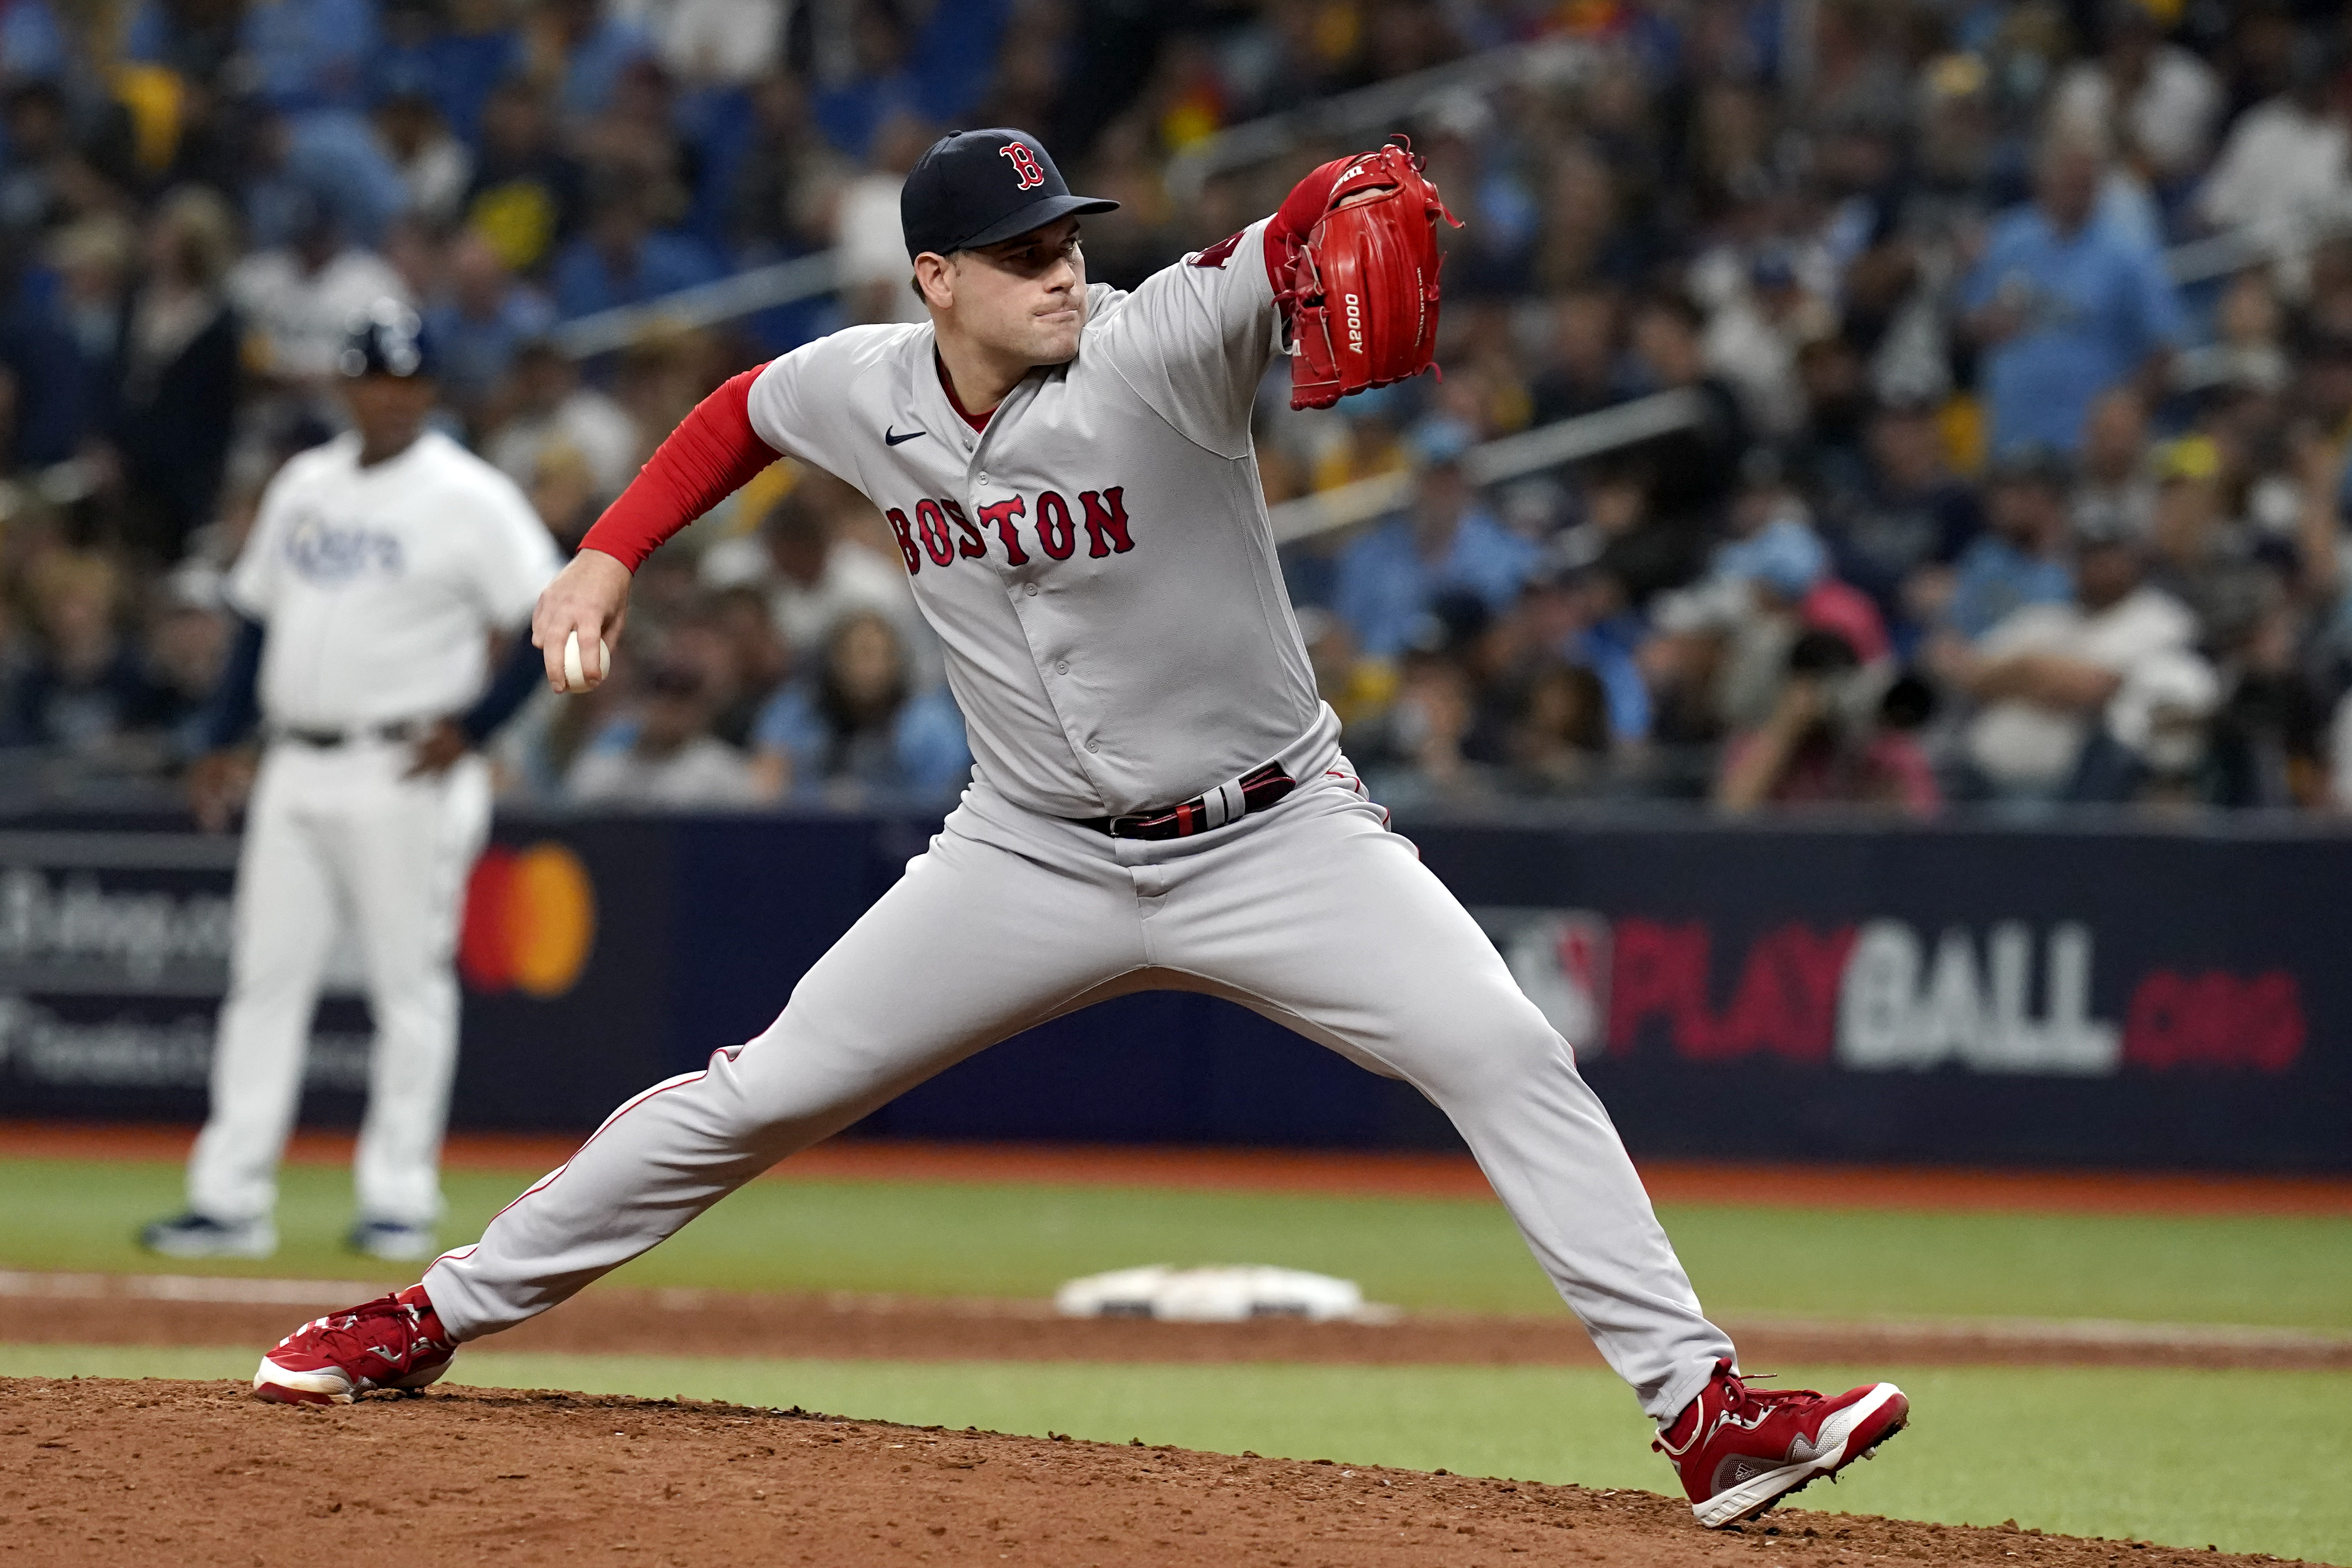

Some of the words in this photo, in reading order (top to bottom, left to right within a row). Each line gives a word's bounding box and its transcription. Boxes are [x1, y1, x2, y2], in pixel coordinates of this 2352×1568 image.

[999, 142, 1044, 191] B
[1345, 294, 1363, 355] A2000
[885, 485, 1135, 576] BOSTON
